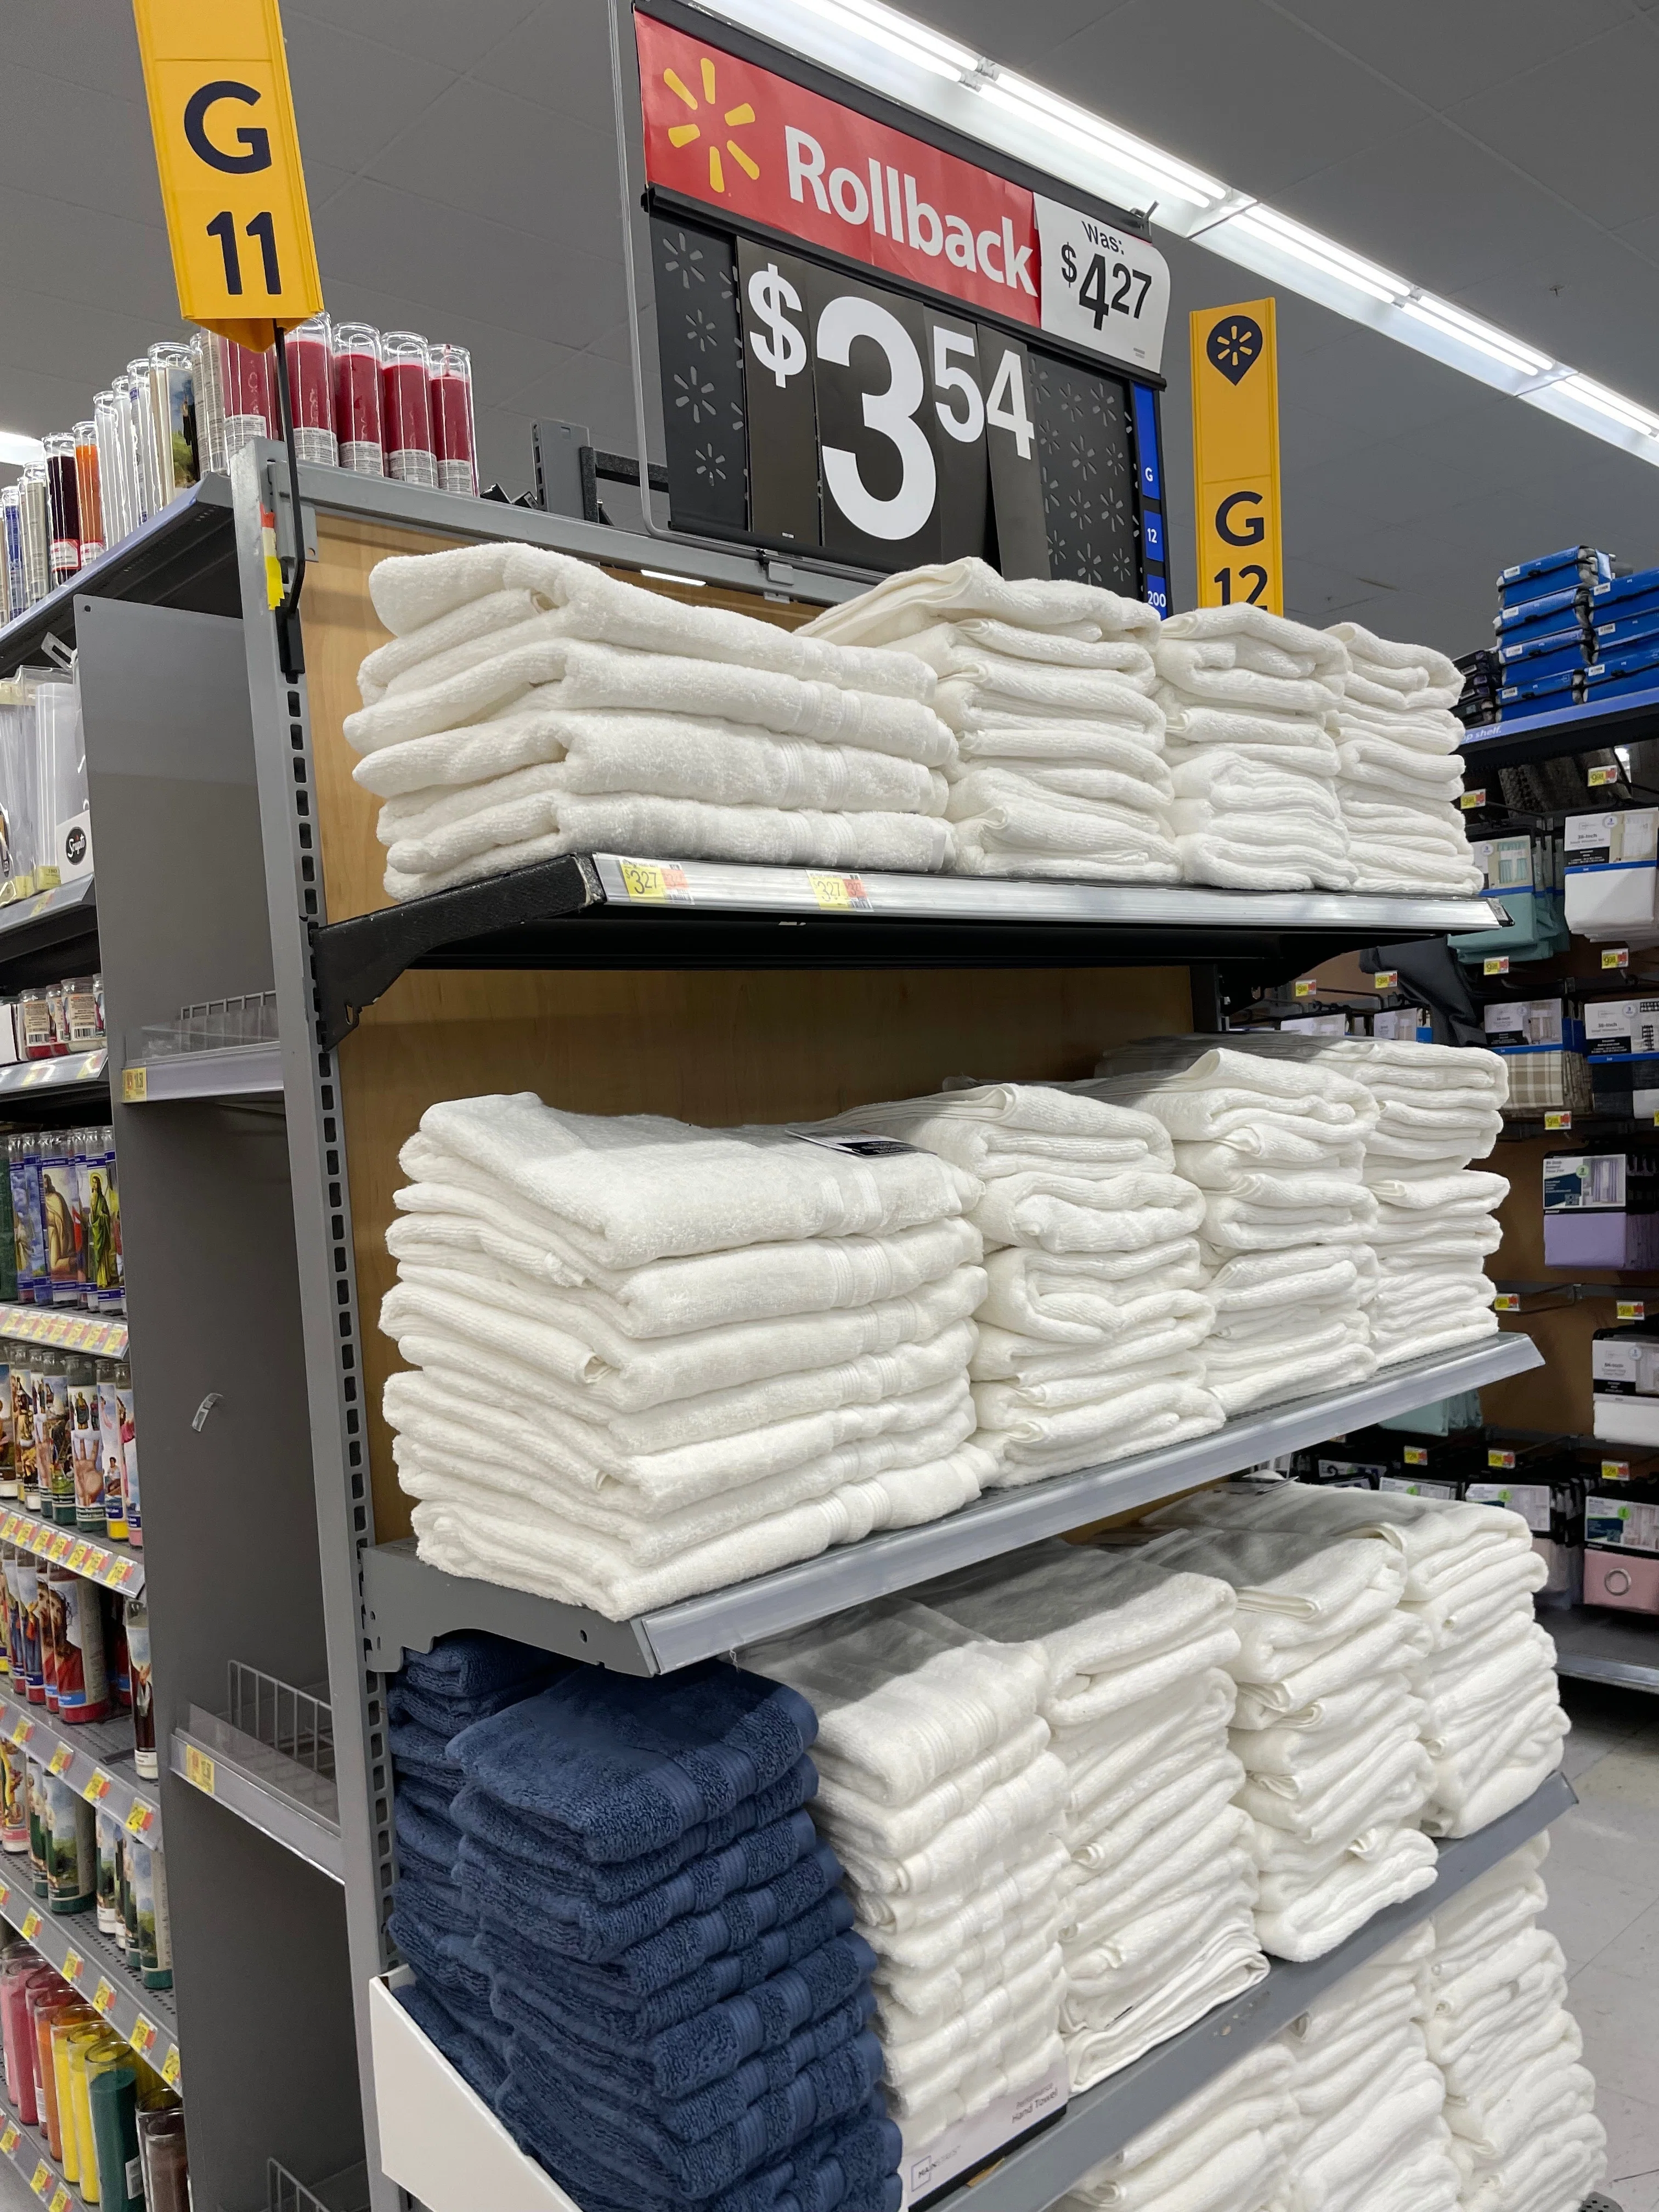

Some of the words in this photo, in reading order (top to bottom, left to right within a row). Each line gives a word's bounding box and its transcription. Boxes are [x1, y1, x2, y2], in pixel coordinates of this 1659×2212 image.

[184, 81, 272, 174] G
[785, 125, 1039, 297] Rollback
[206, 211, 281, 295] 11
[1081, 221, 1124, 255] Was:
[1145, 467, 1153, 482] G
[1147, 528, 1158, 544] 12
[1215, 491, 1265, 546] G
[1147, 590, 1166, 607] 200
[1214, 565, 1268, 611] 12
